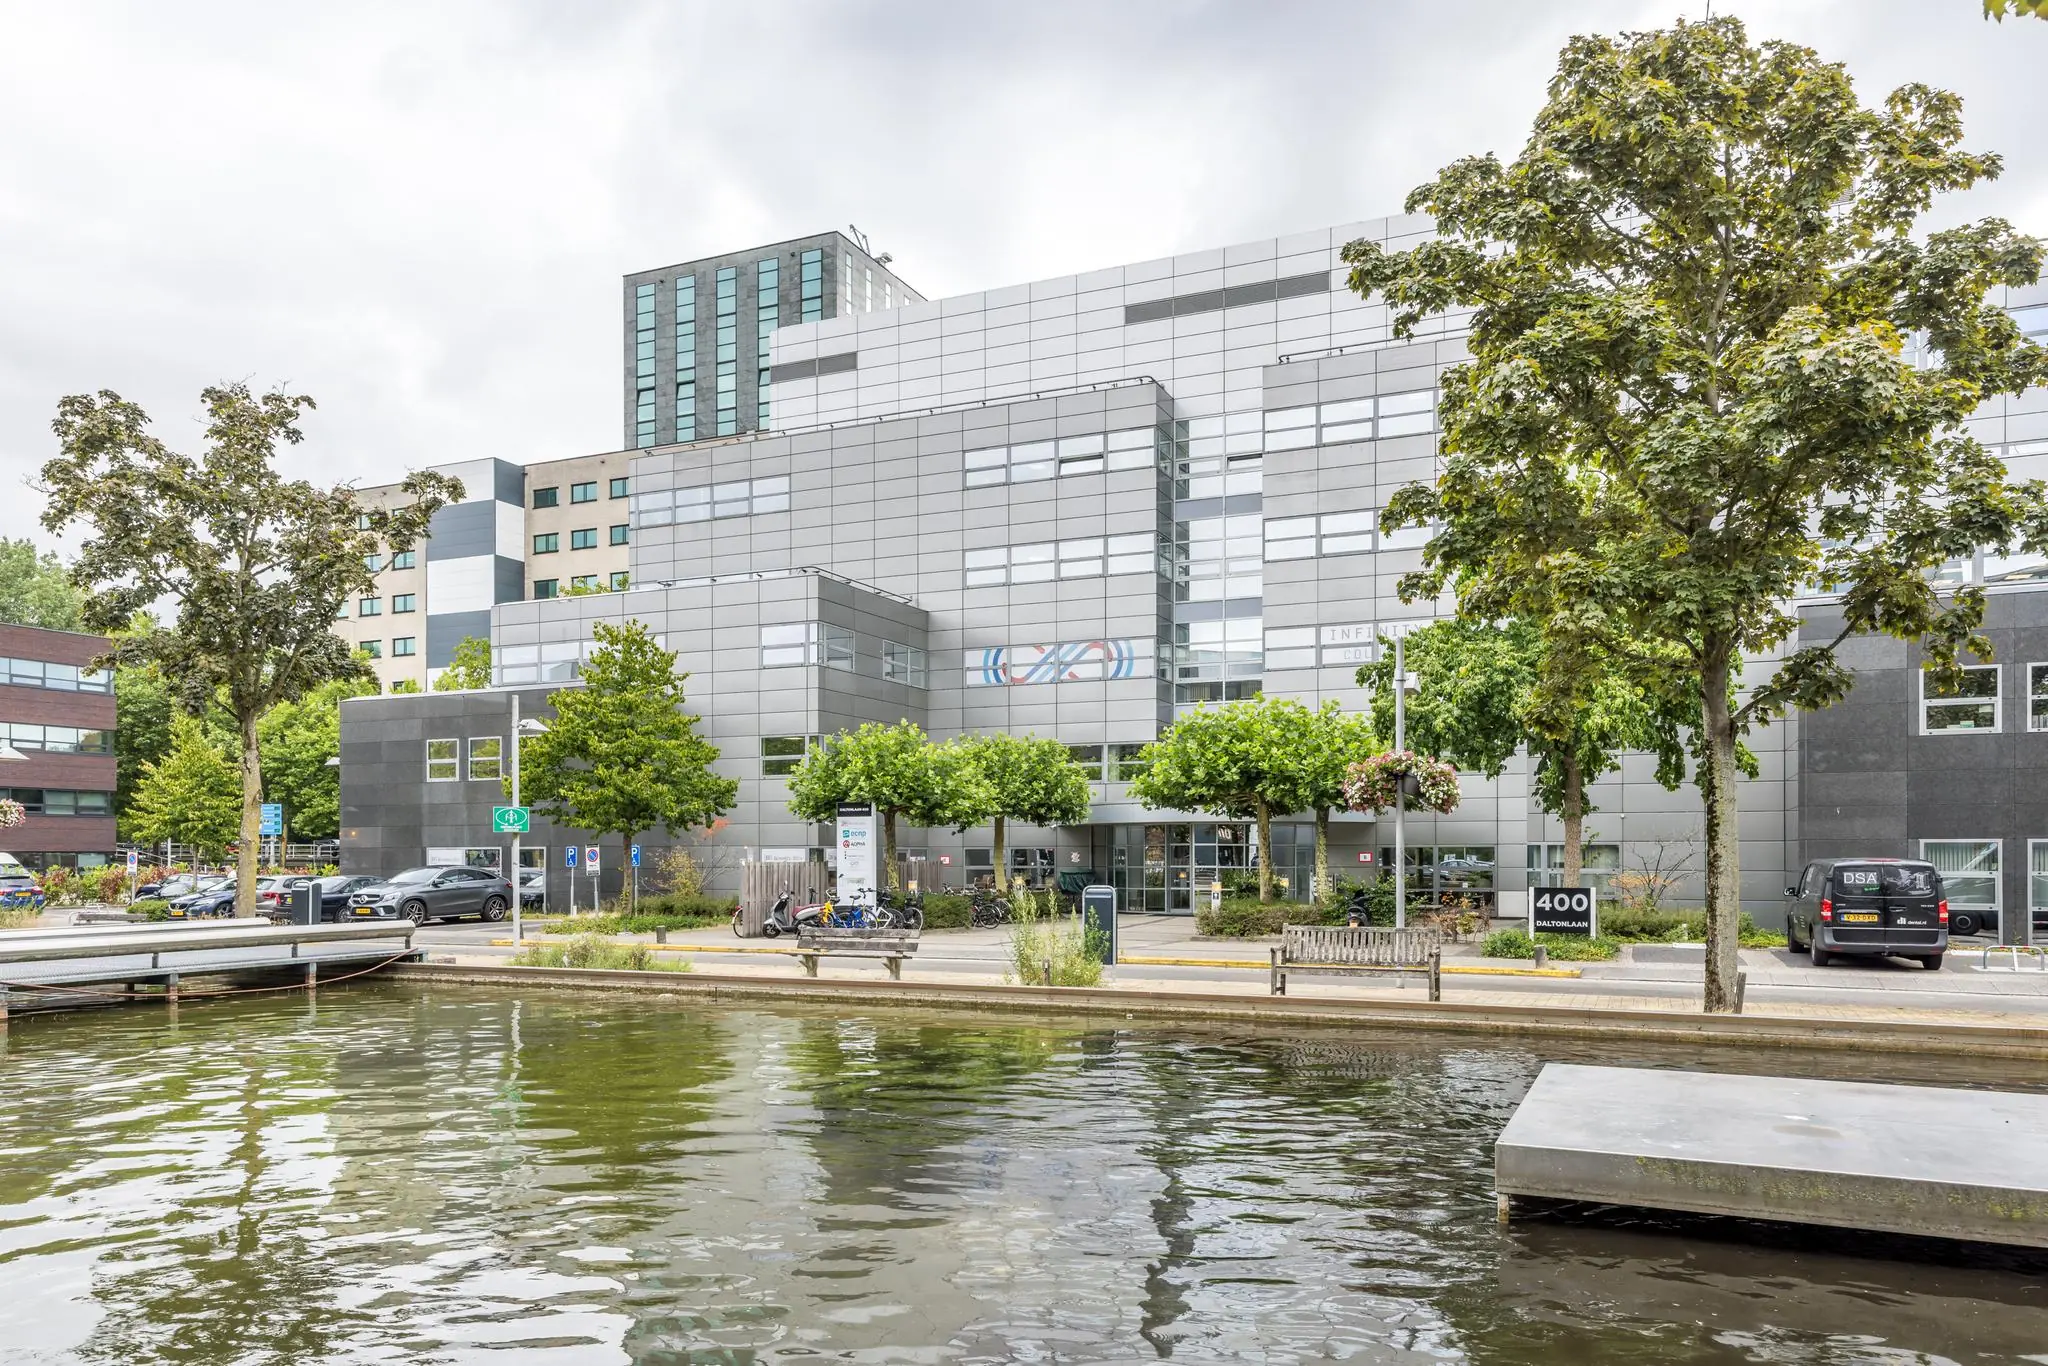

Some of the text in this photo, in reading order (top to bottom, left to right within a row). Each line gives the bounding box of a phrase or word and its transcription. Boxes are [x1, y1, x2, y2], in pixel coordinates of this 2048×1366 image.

[1330, 623, 1423, 640] INFINITY
[568, 848, 575, 859] P
[631, 847, 638, 858] P
[1536, 893, 1589, 912] 400
